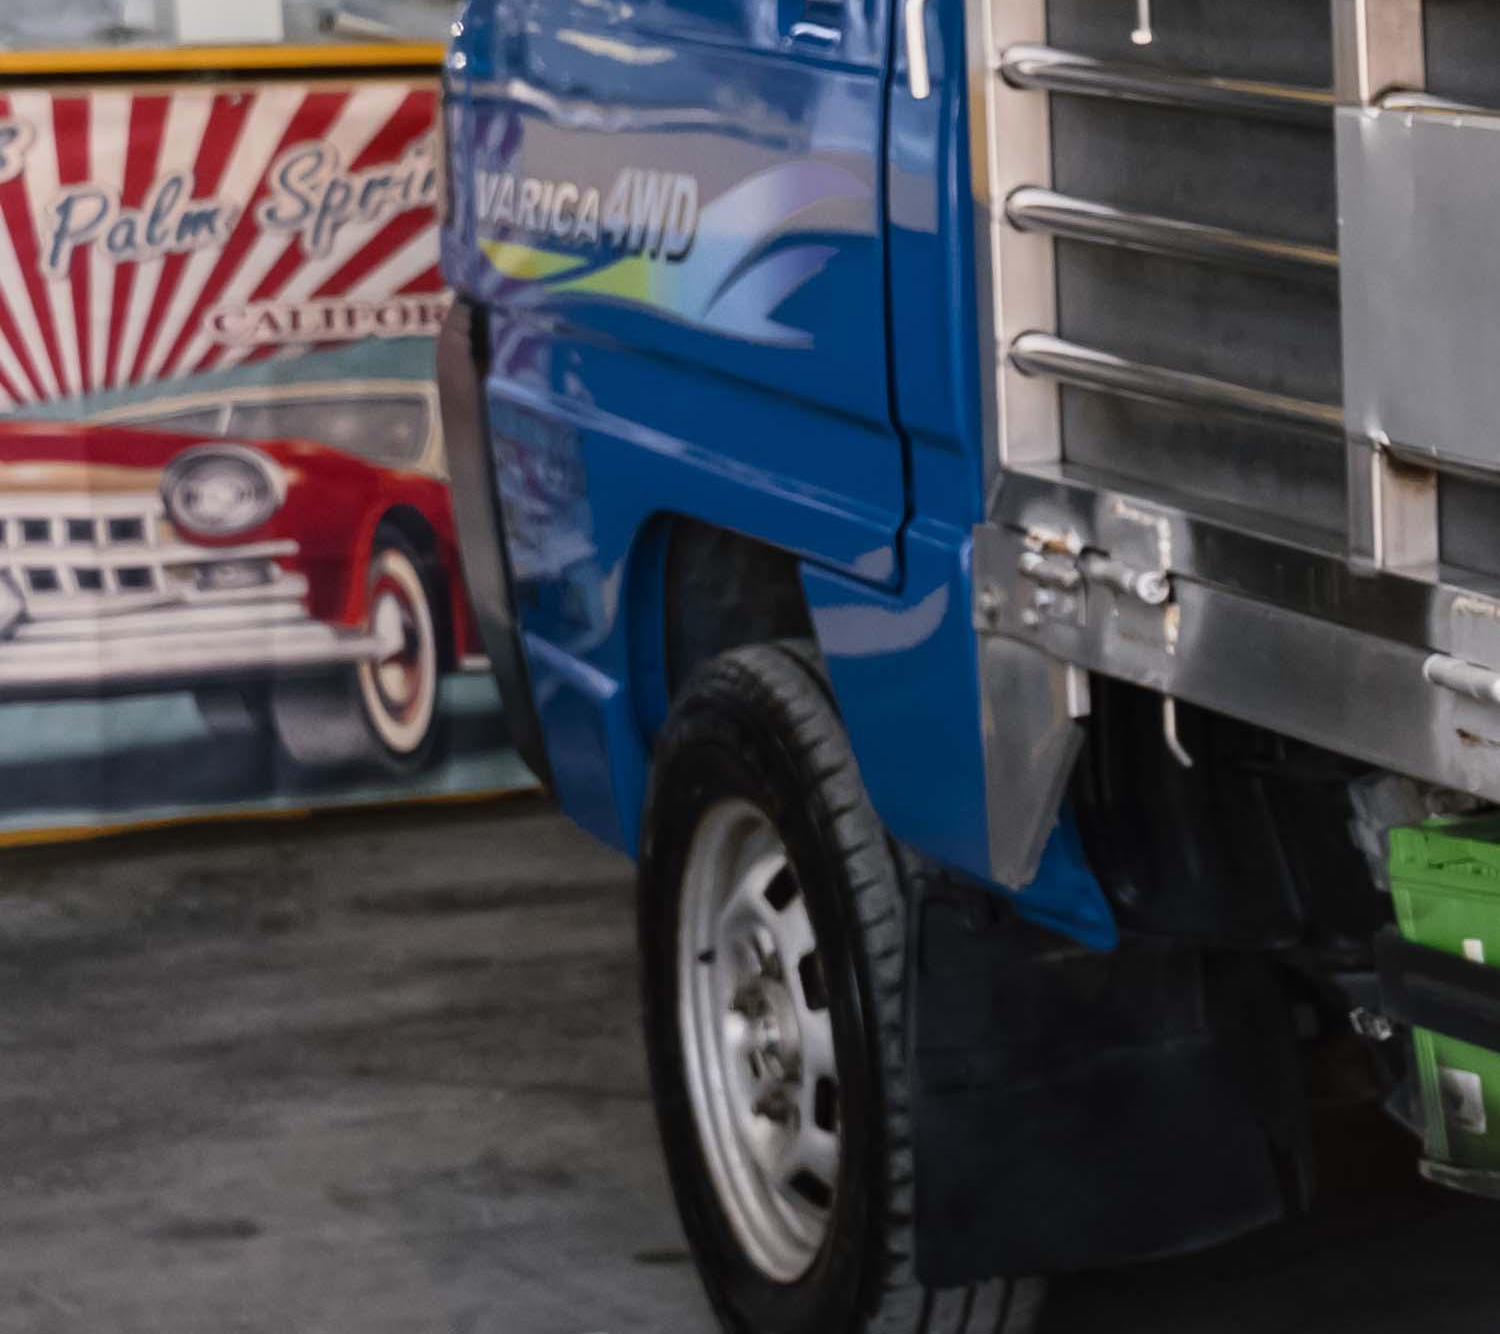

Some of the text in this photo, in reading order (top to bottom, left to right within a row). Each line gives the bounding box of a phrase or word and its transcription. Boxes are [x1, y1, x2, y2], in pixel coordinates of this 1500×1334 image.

[48, 175, 220, 269] Palm
[474, 168, 700, 265] VARICA 4WD
